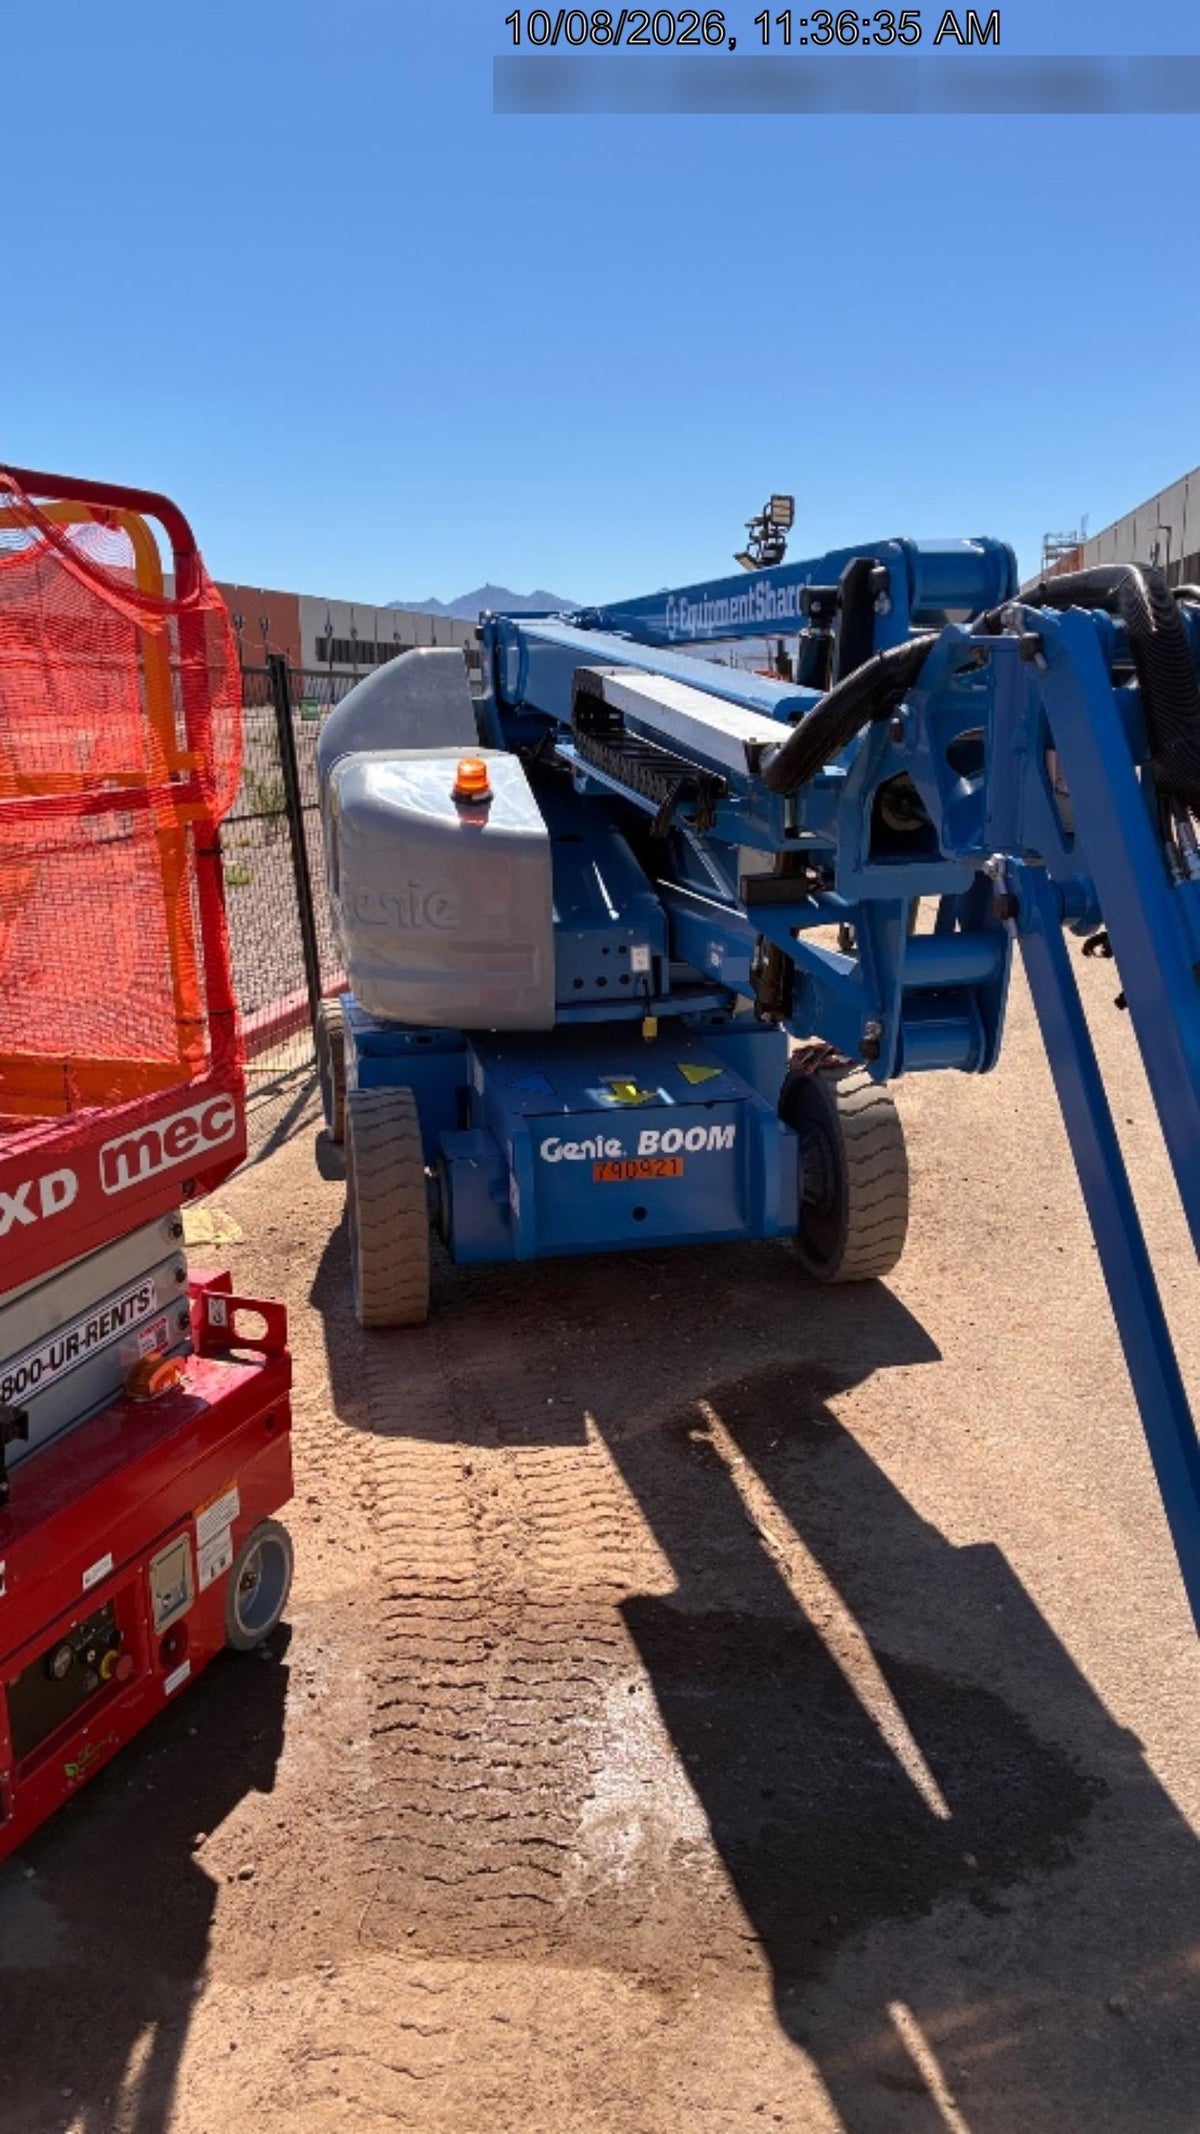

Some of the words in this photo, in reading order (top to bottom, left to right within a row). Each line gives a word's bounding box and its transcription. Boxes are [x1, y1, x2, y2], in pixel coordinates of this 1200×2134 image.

[101, 1100, 234, 1190] mec
[539, 1136, 623, 1163] Genie
[637, 1124, 737, 1155] BOOM
[599, 1158, 679, 1180] 790921
